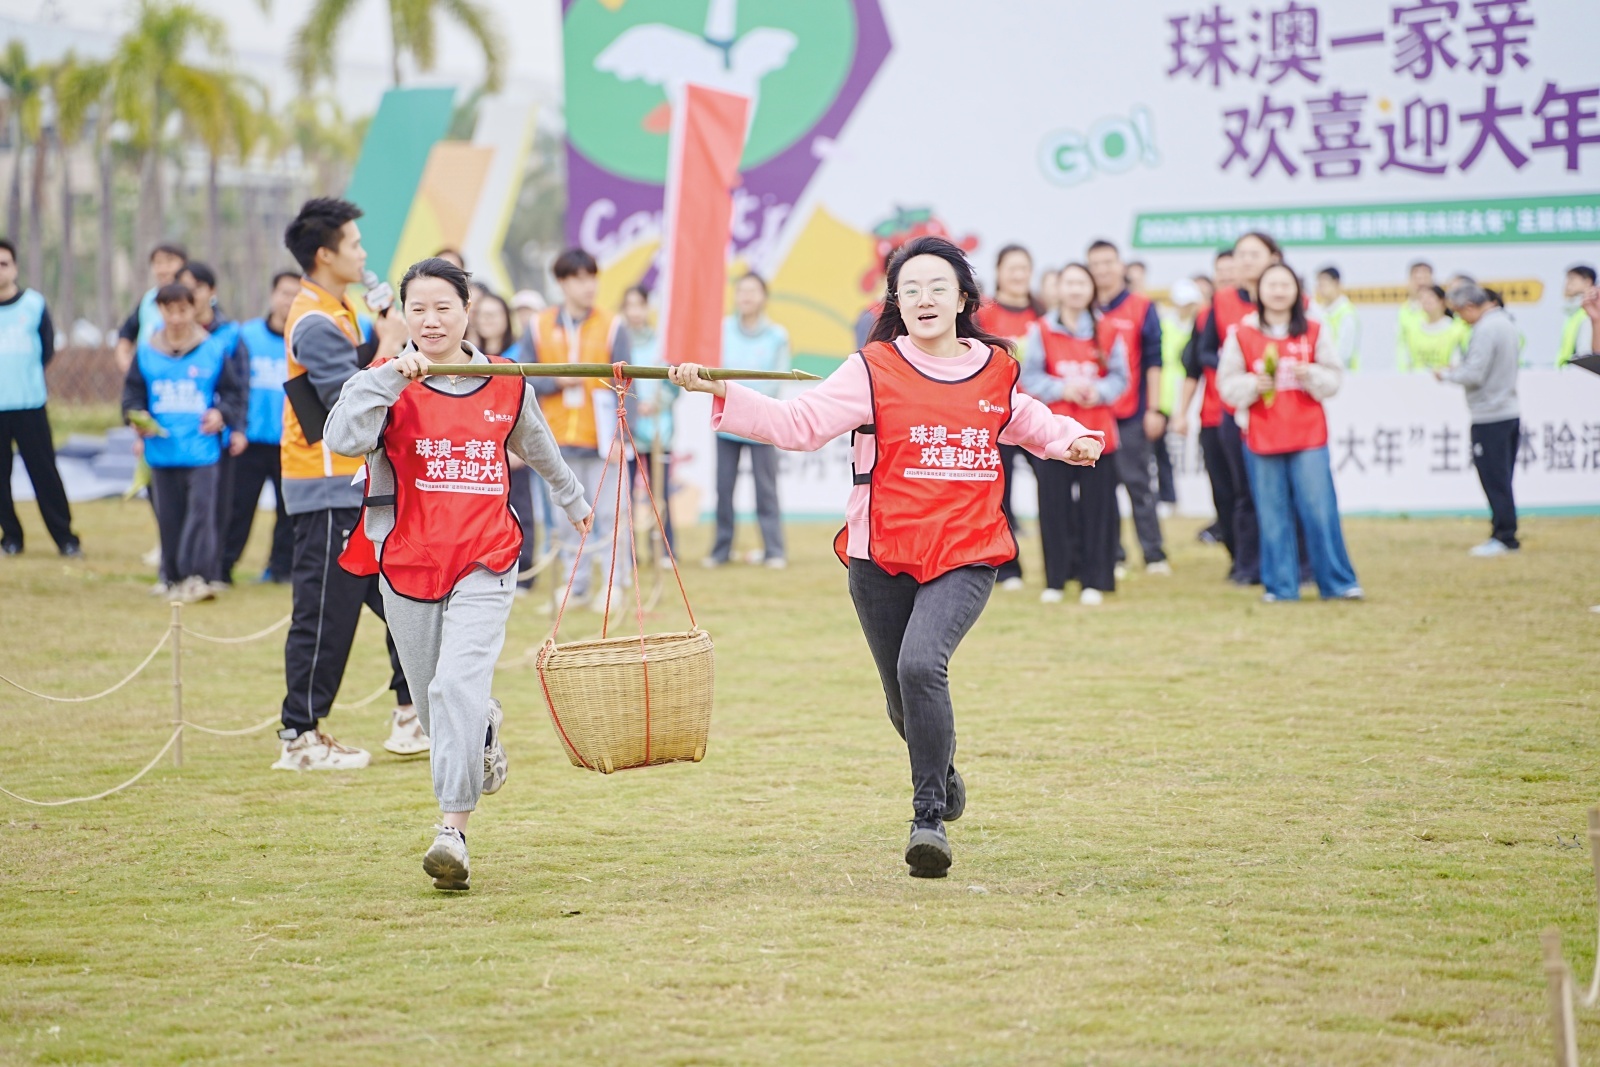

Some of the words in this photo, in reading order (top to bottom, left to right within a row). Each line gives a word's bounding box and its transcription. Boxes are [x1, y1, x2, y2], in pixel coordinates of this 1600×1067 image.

[1168, 0, 1534, 86] 珠澳一家亲
[1220, 83, 1600, 178] 欢喜迎大年
[909, 425, 990, 448] 珠澳一家亲
[415, 438, 497, 460] 珠澳一家亲
[920, 446, 1001, 470] 欢喜迎大年
[426, 458, 504, 482] 欢喜迎大年
